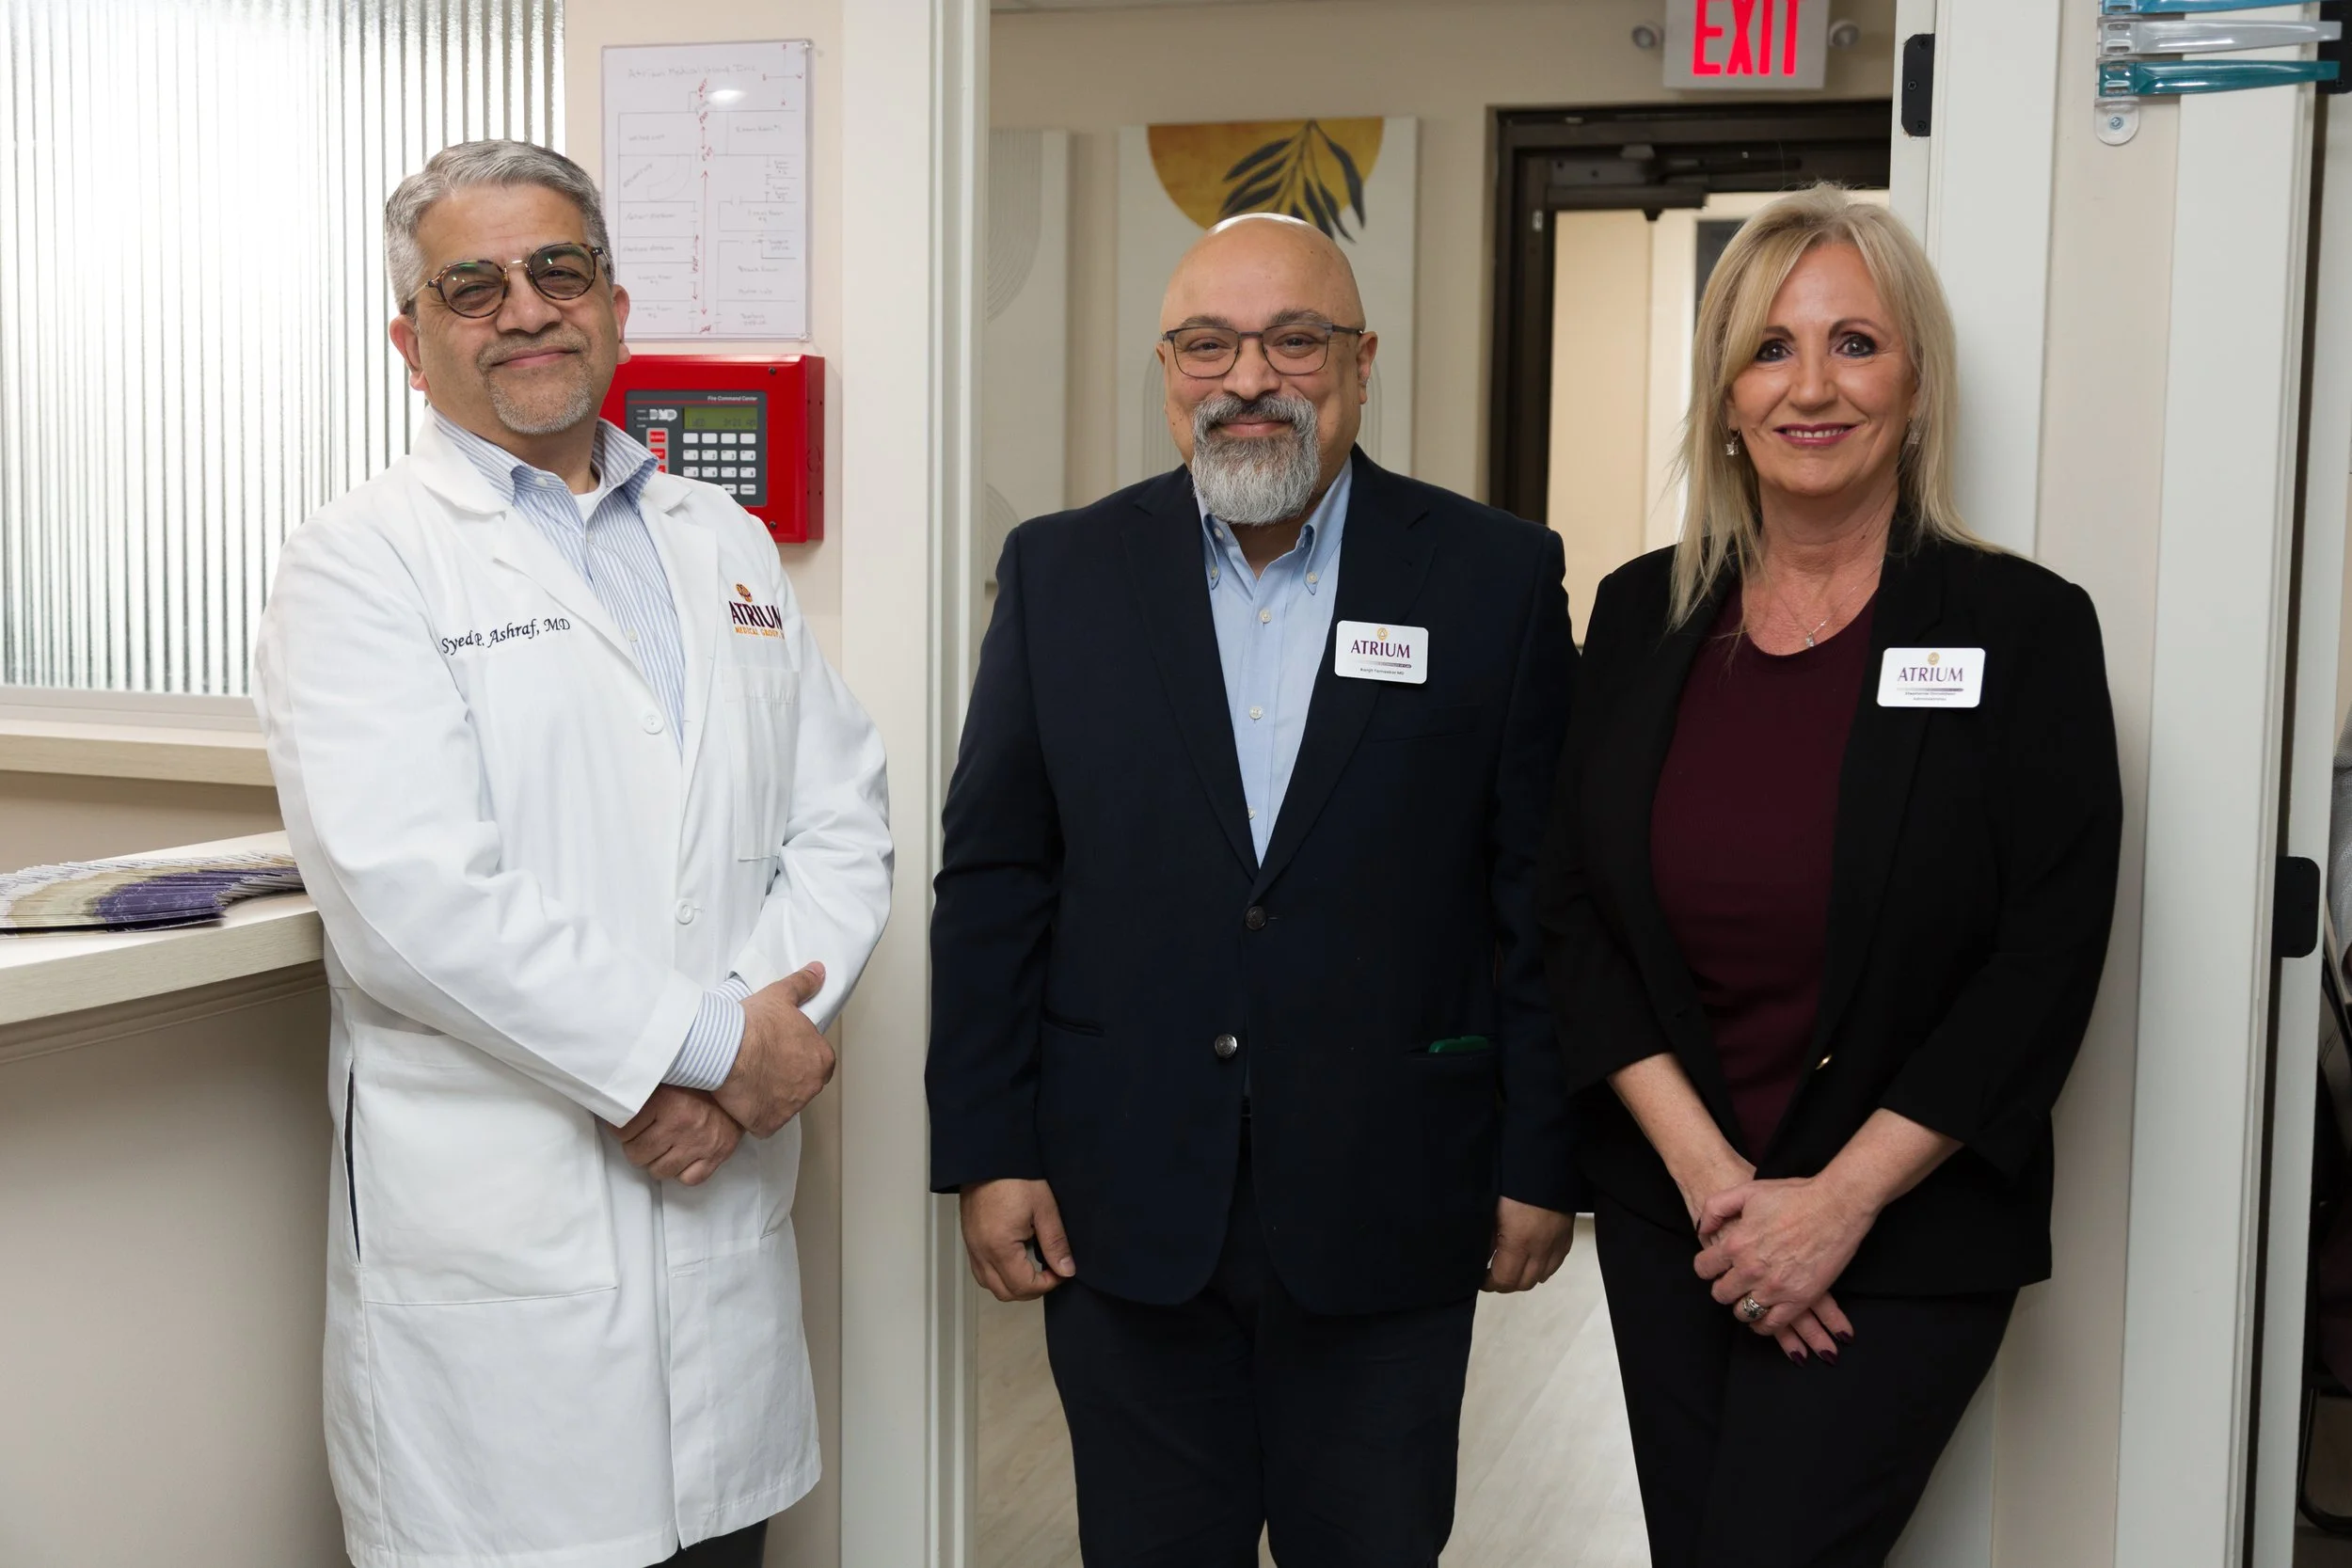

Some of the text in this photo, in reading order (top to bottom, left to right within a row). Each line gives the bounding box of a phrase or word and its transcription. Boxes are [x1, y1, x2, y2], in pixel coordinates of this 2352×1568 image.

[1692, 0, 1799, 75] EXIT
[441, 629, 474, 656] Syed
[487, 618, 540, 648] Ashraf,
[543, 618, 570, 632] MD
[1350, 639, 1410, 658] ATRIUM
[1898, 667, 1963, 682] ATRIUM
